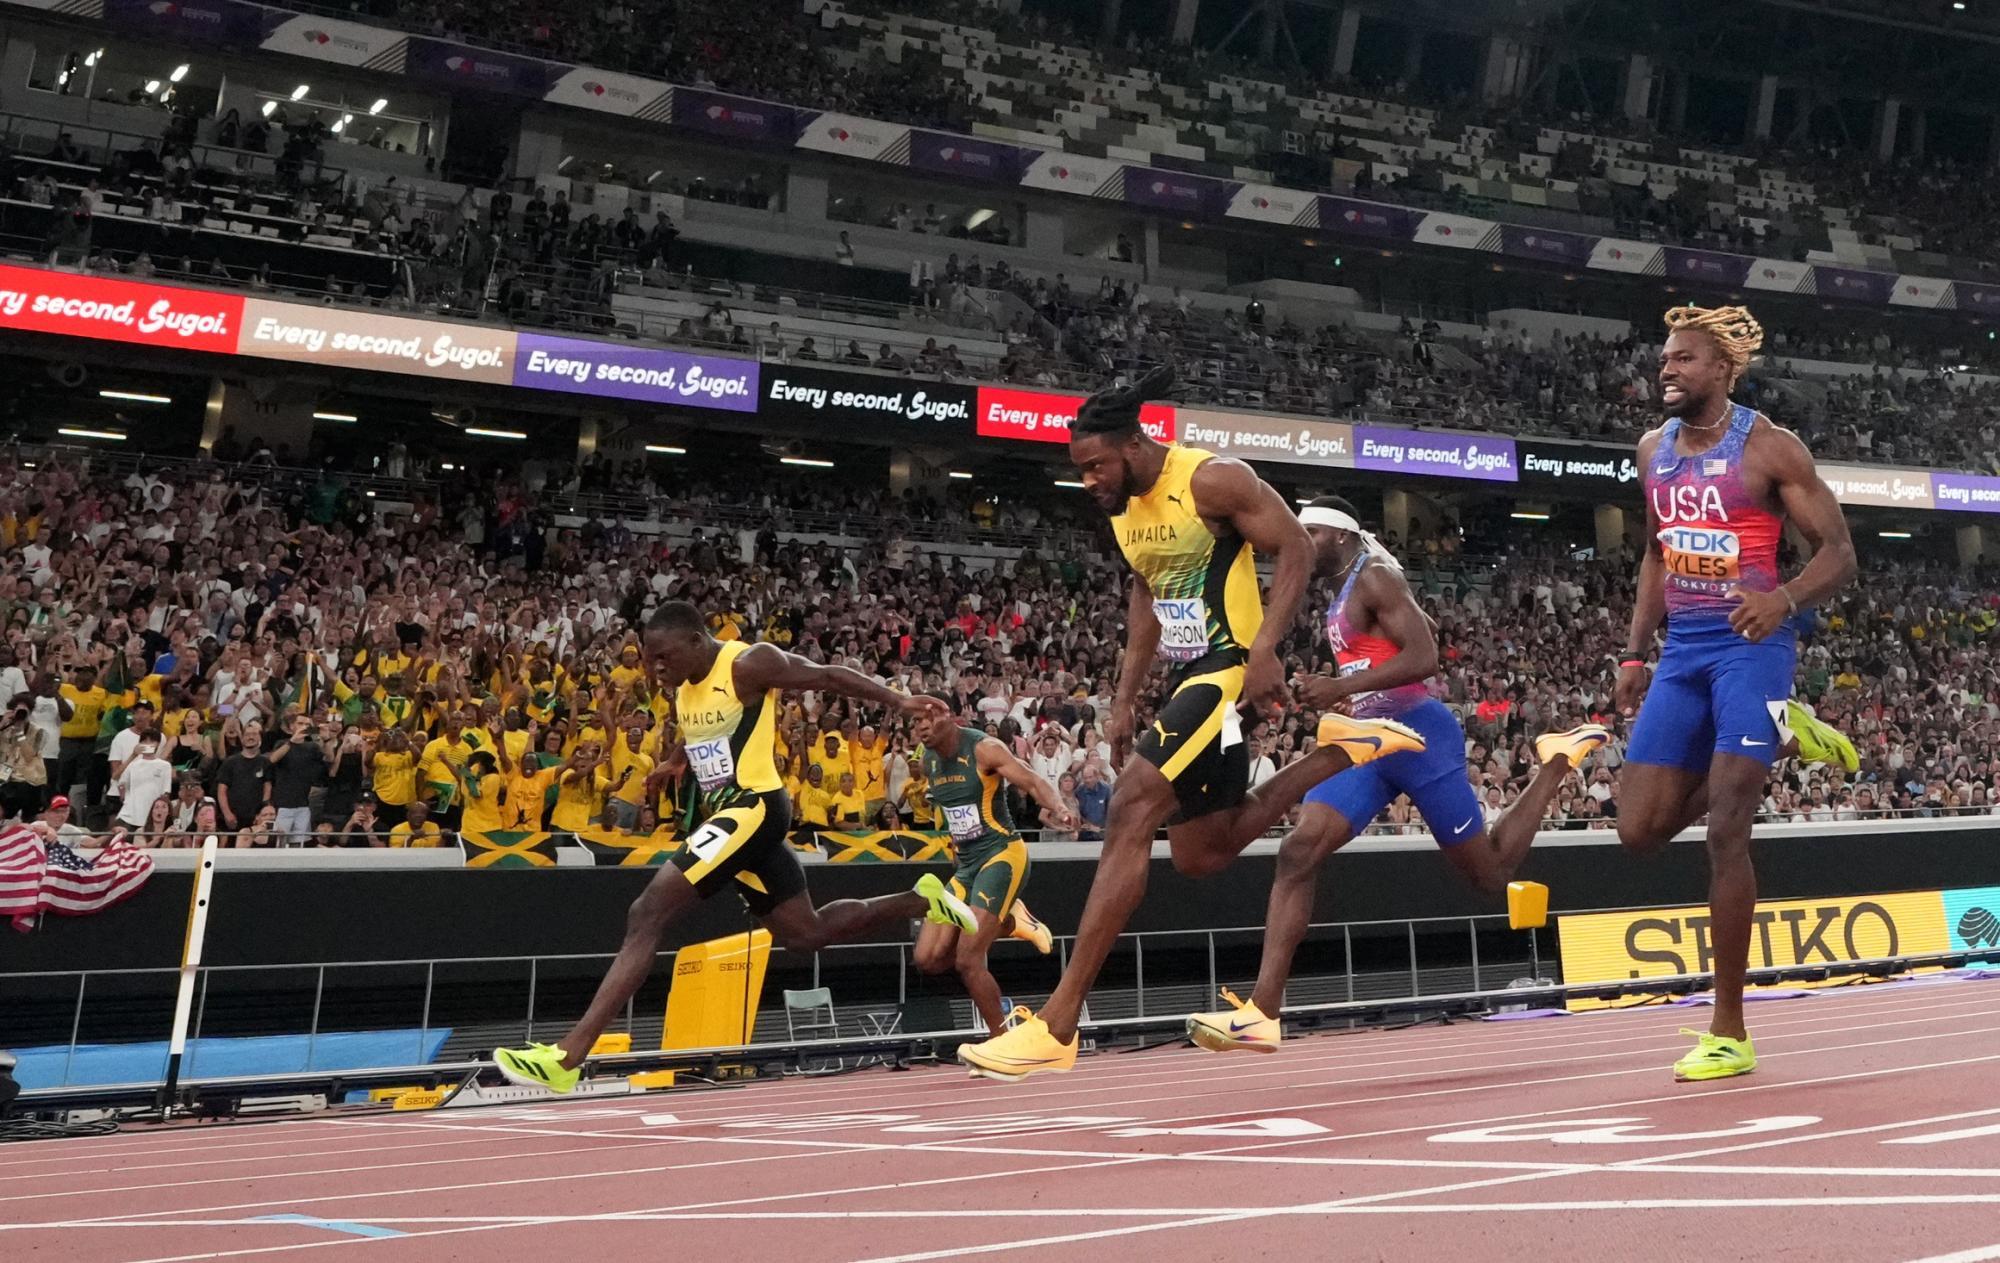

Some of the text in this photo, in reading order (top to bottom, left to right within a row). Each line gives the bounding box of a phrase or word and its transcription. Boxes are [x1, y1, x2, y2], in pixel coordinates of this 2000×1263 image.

[31, 294, 136, 326] second,
[138, 299, 227, 337] Sugoi.
[253, 317, 504, 369] Every second, Sugoi.
[526, 350, 749, 398] Every second, Sugoi.
[769, 379, 969, 421] Every second, Sugoi.
[987, 402, 1039, 431] Every
[1183, 423, 1347, 457] Every second, Sugoi.
[1362, 439, 1511, 471] Every second, Sugoi.
[1524, 454, 1563, 477] Every
[1566, 460, 1617, 479] second,
[1846, 481, 1890, 497] second,
[1937, 484, 1970, 504] Every
[1653, 485, 1729, 523] USA
[1125, 524, 1177, 547] JAMAICA
[1673, 529, 1733, 553] TDK
[1671, 554, 1729, 577] YLES
[1158, 602, 1198, 621] TDK
[1162, 624, 1204, 645] MPSON
[679, 710, 726, 728] MAICA
[688, 741, 724, 761] TDK
[949, 806, 974, 820] TDK
[696, 830, 719, 849] 7
[404, 1095, 441, 1106] SEIKO
